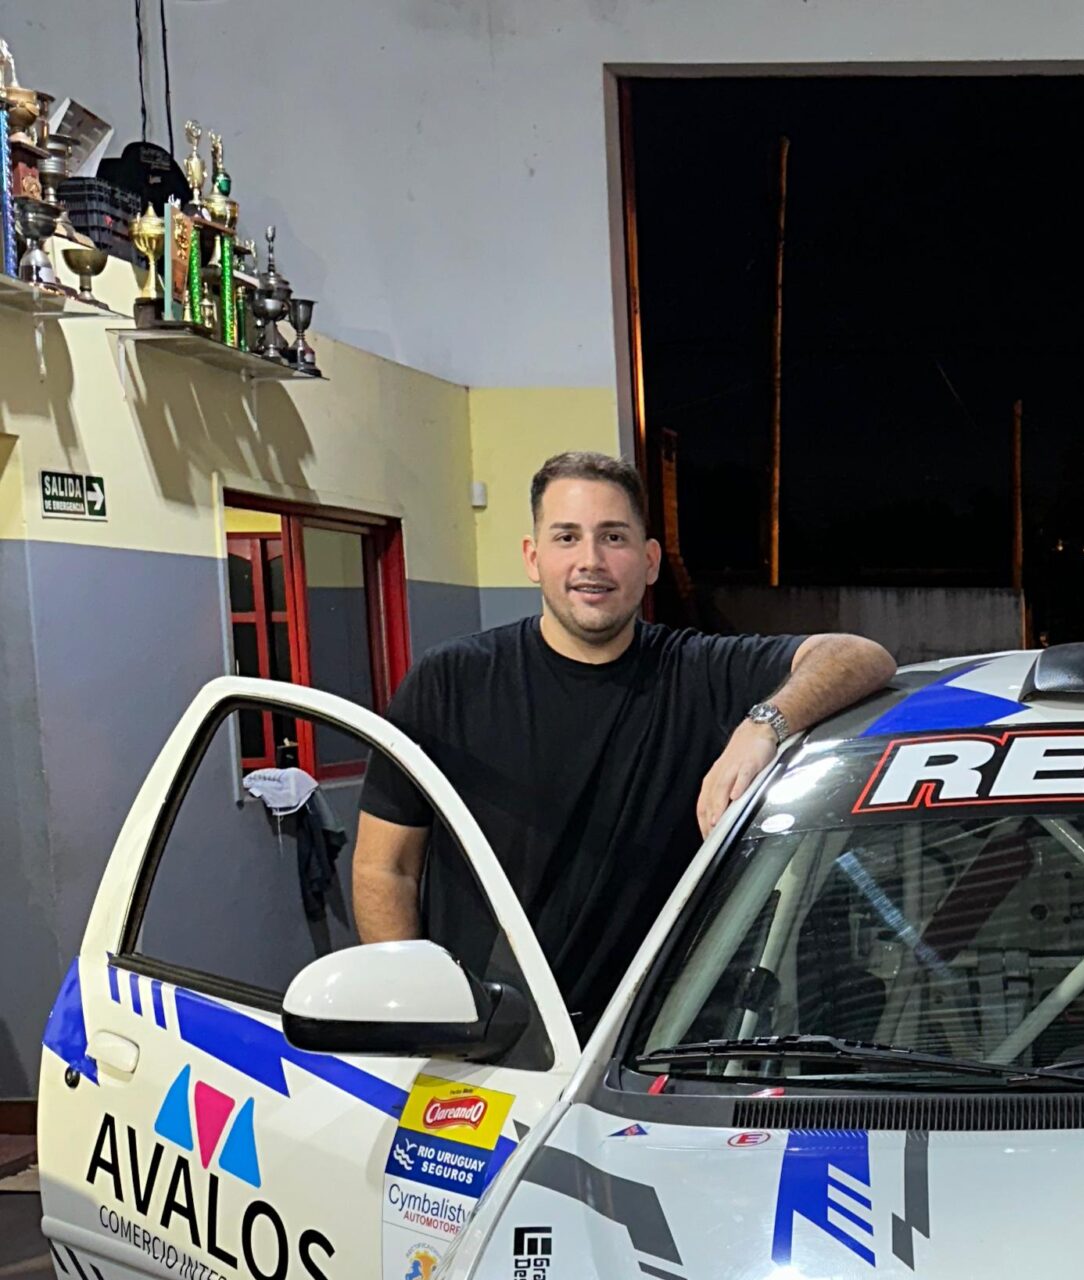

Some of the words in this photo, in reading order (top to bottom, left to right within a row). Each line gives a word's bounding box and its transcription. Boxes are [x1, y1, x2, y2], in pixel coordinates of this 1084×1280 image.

[44, 475, 82, 498] SALIDA
[416, 1145, 436, 1159] RIO
[436, 1150, 486, 1173] URUGUAY
[420, 1161, 474, 1185] SEGUROS
[99, 1204, 178, 1270] COMERCIO
